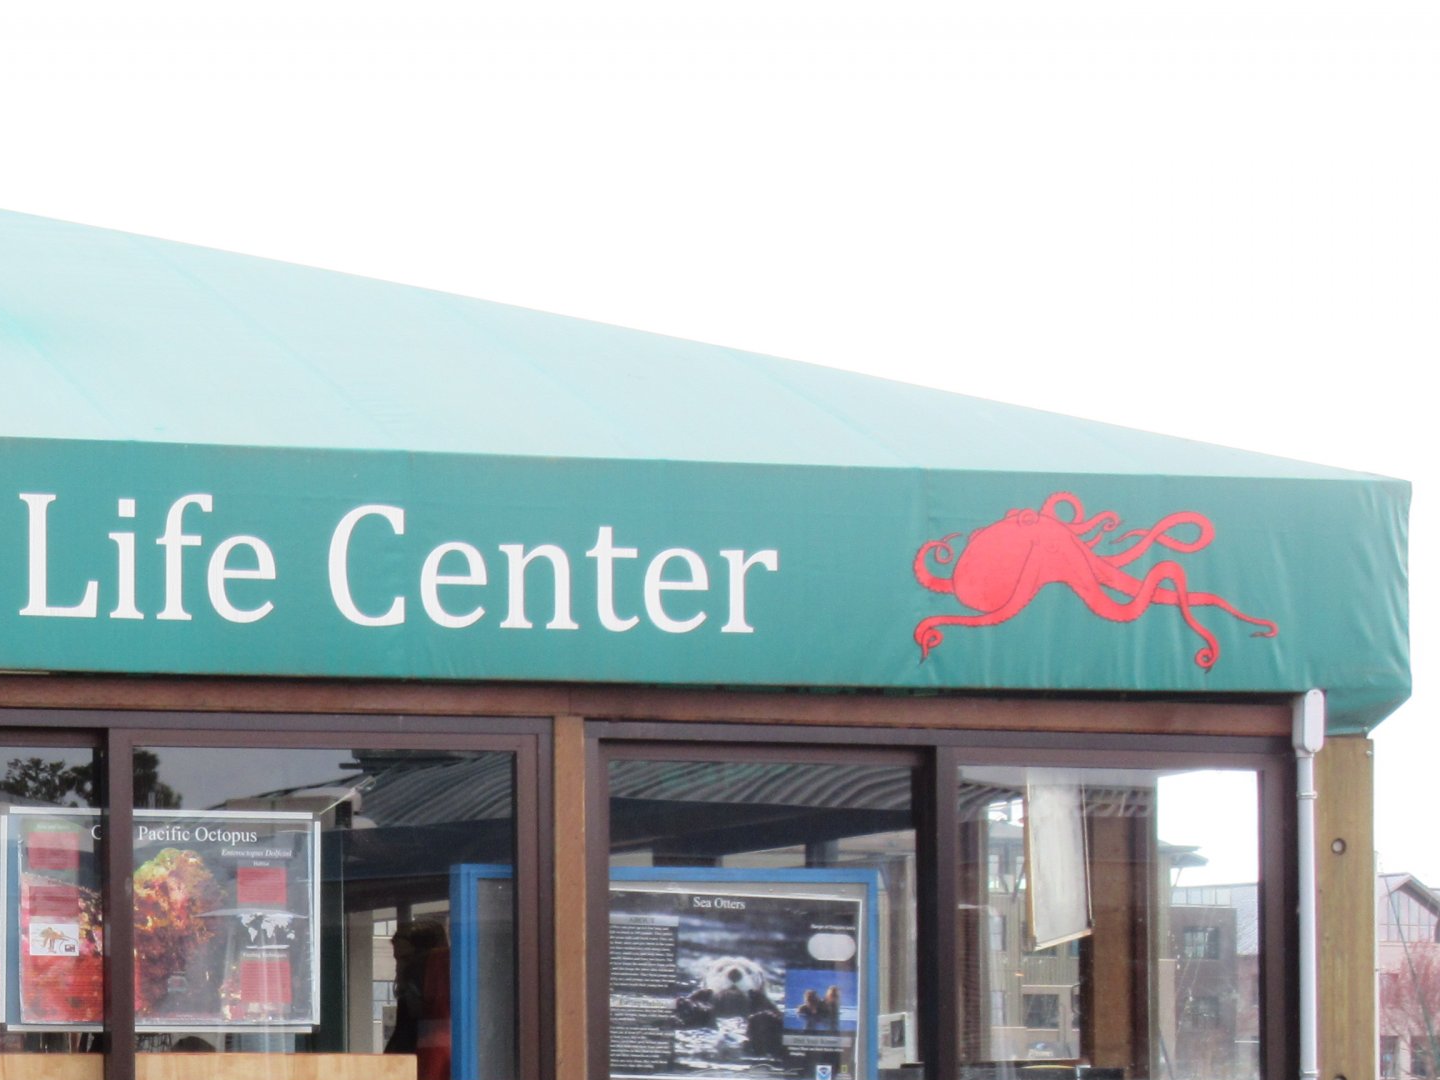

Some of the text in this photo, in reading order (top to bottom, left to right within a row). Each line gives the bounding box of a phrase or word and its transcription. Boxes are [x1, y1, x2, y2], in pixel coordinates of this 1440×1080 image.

[19, 493, 276, 622] Life
[328, 504, 778, 633] Center
[138, 825, 258, 847] Pacific Octopus
[693, 896, 746, 910] Sea Otters
